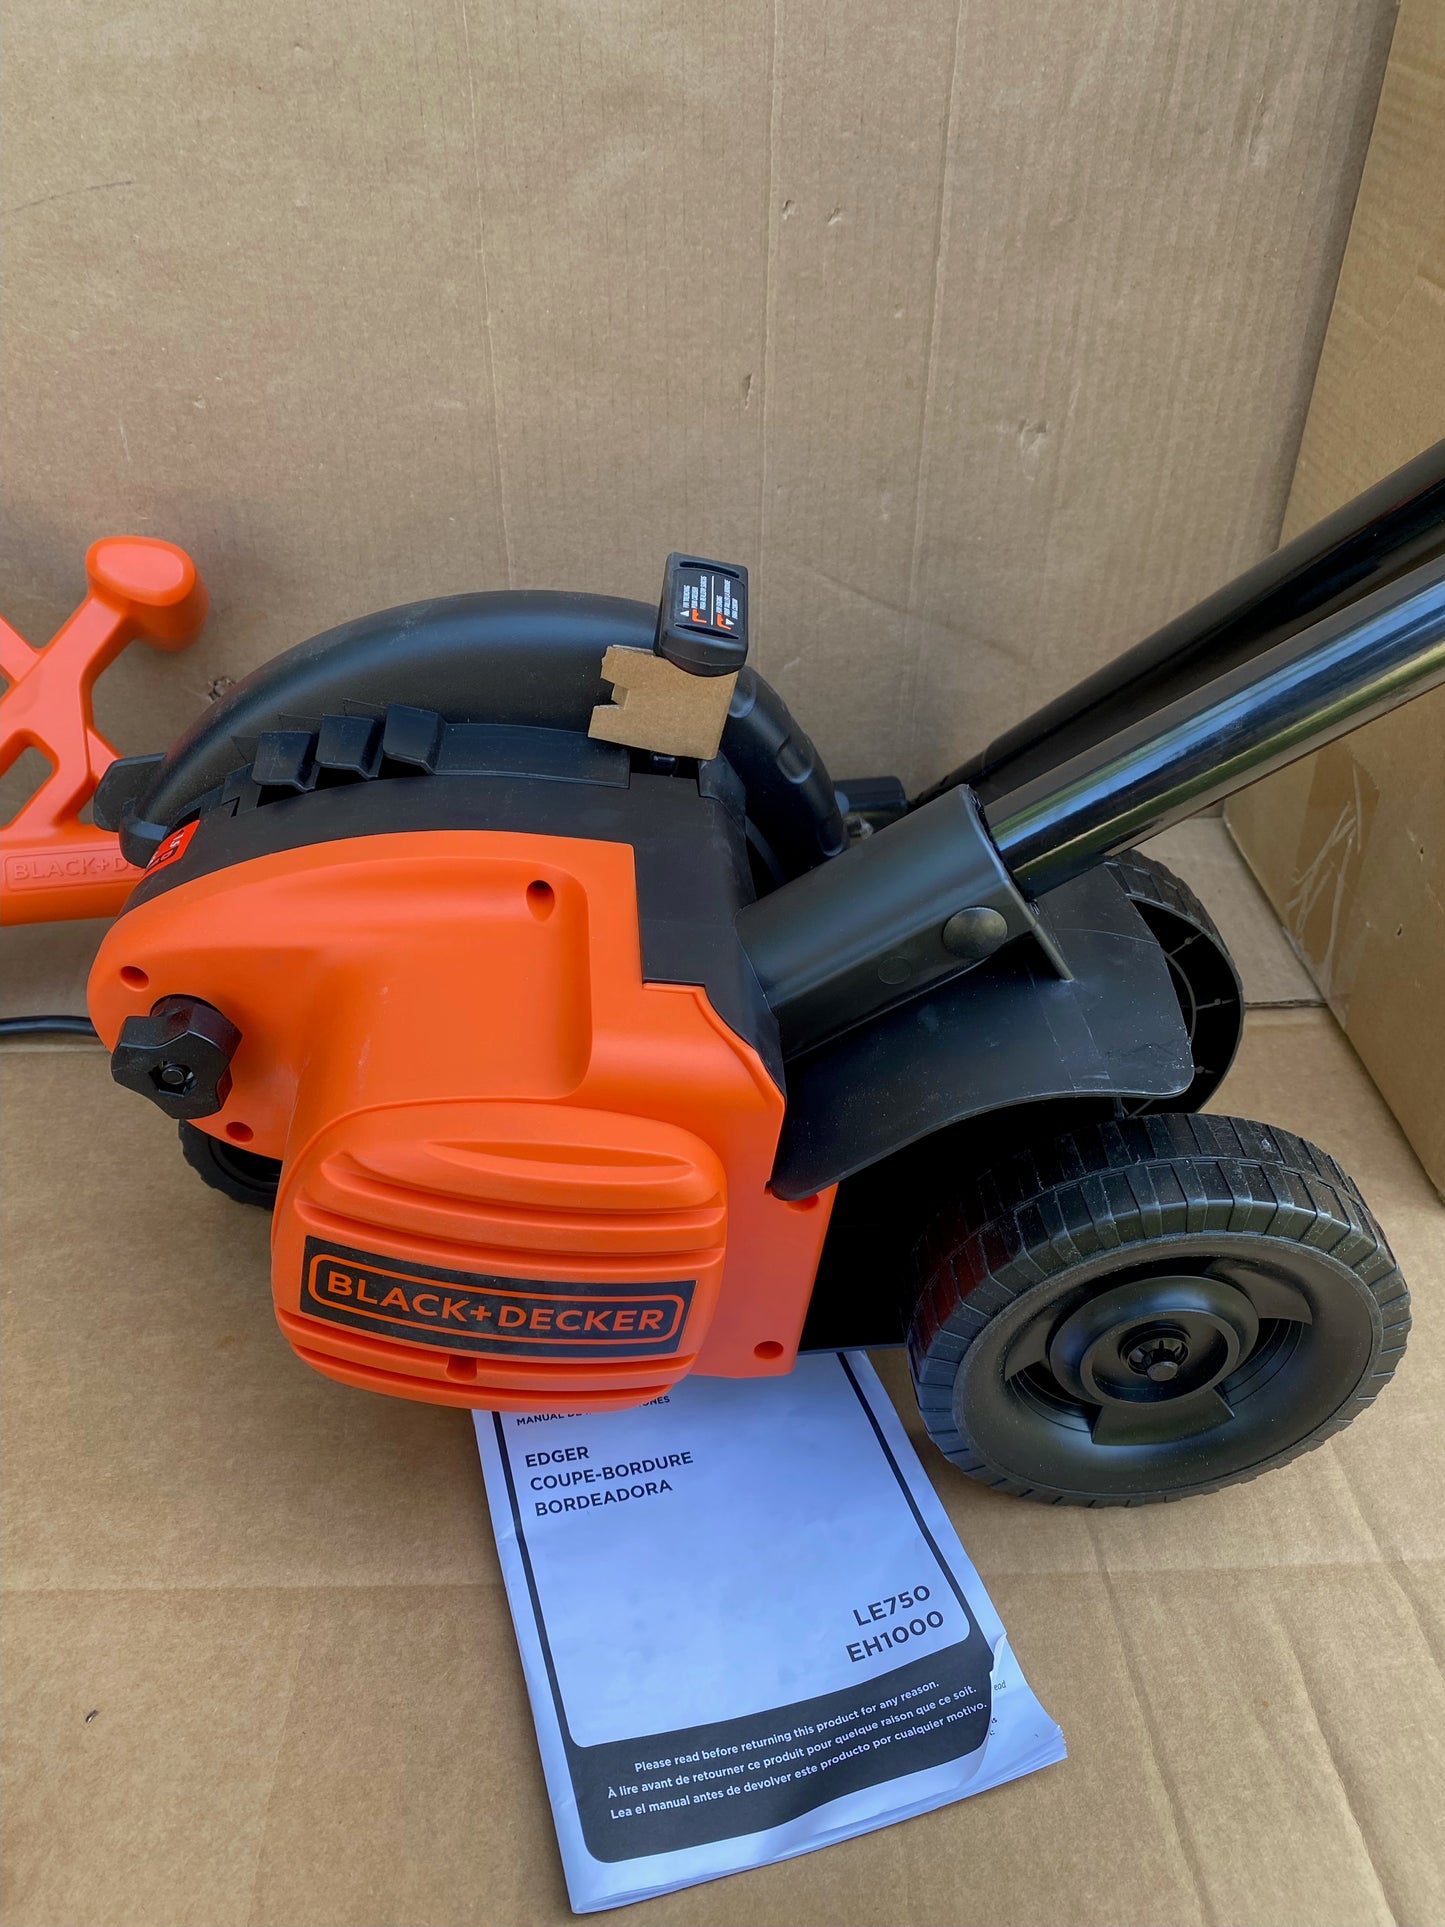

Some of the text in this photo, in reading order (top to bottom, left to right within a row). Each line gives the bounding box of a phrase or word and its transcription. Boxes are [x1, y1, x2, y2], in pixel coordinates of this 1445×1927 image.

[14, 856, 138, 881] BLACK+D
[327, 1270, 664, 1332] BLACK+DECKER
[516, 1413, 565, 1426] MANUAL
[525, 1446, 590, 1468] EDGER
[530, 1451, 694, 1491] COUPE-BORDURE
[535, 1479, 673, 1517] BORDEADORA
[853, 1585, 931, 1627] LE750
[845, 1610, 944, 1663] EH1000
[607, 1685, 977, 1799] À lire avant de retourner ce produit pour quelque raison que ce soit.
[634, 1681, 940, 1773] Please read before returning this product for any reason.
[610, 1806, 633, 1819] Lea
[635, 1803, 646, 1815] el
[648, 1795, 691, 1813] manual
[693, 1790, 724, 1804] antes
[726, 1784, 741, 1796] de
[743, 1772, 792, 1793] devolver
[794, 1766, 818, 1779] este
[820, 1742, 871, 1771] producto
[872, 1735, 892, 1750] por
[894, 1718, 945, 1741] cualquier
[946, 1702, 988, 1723] motivo.
